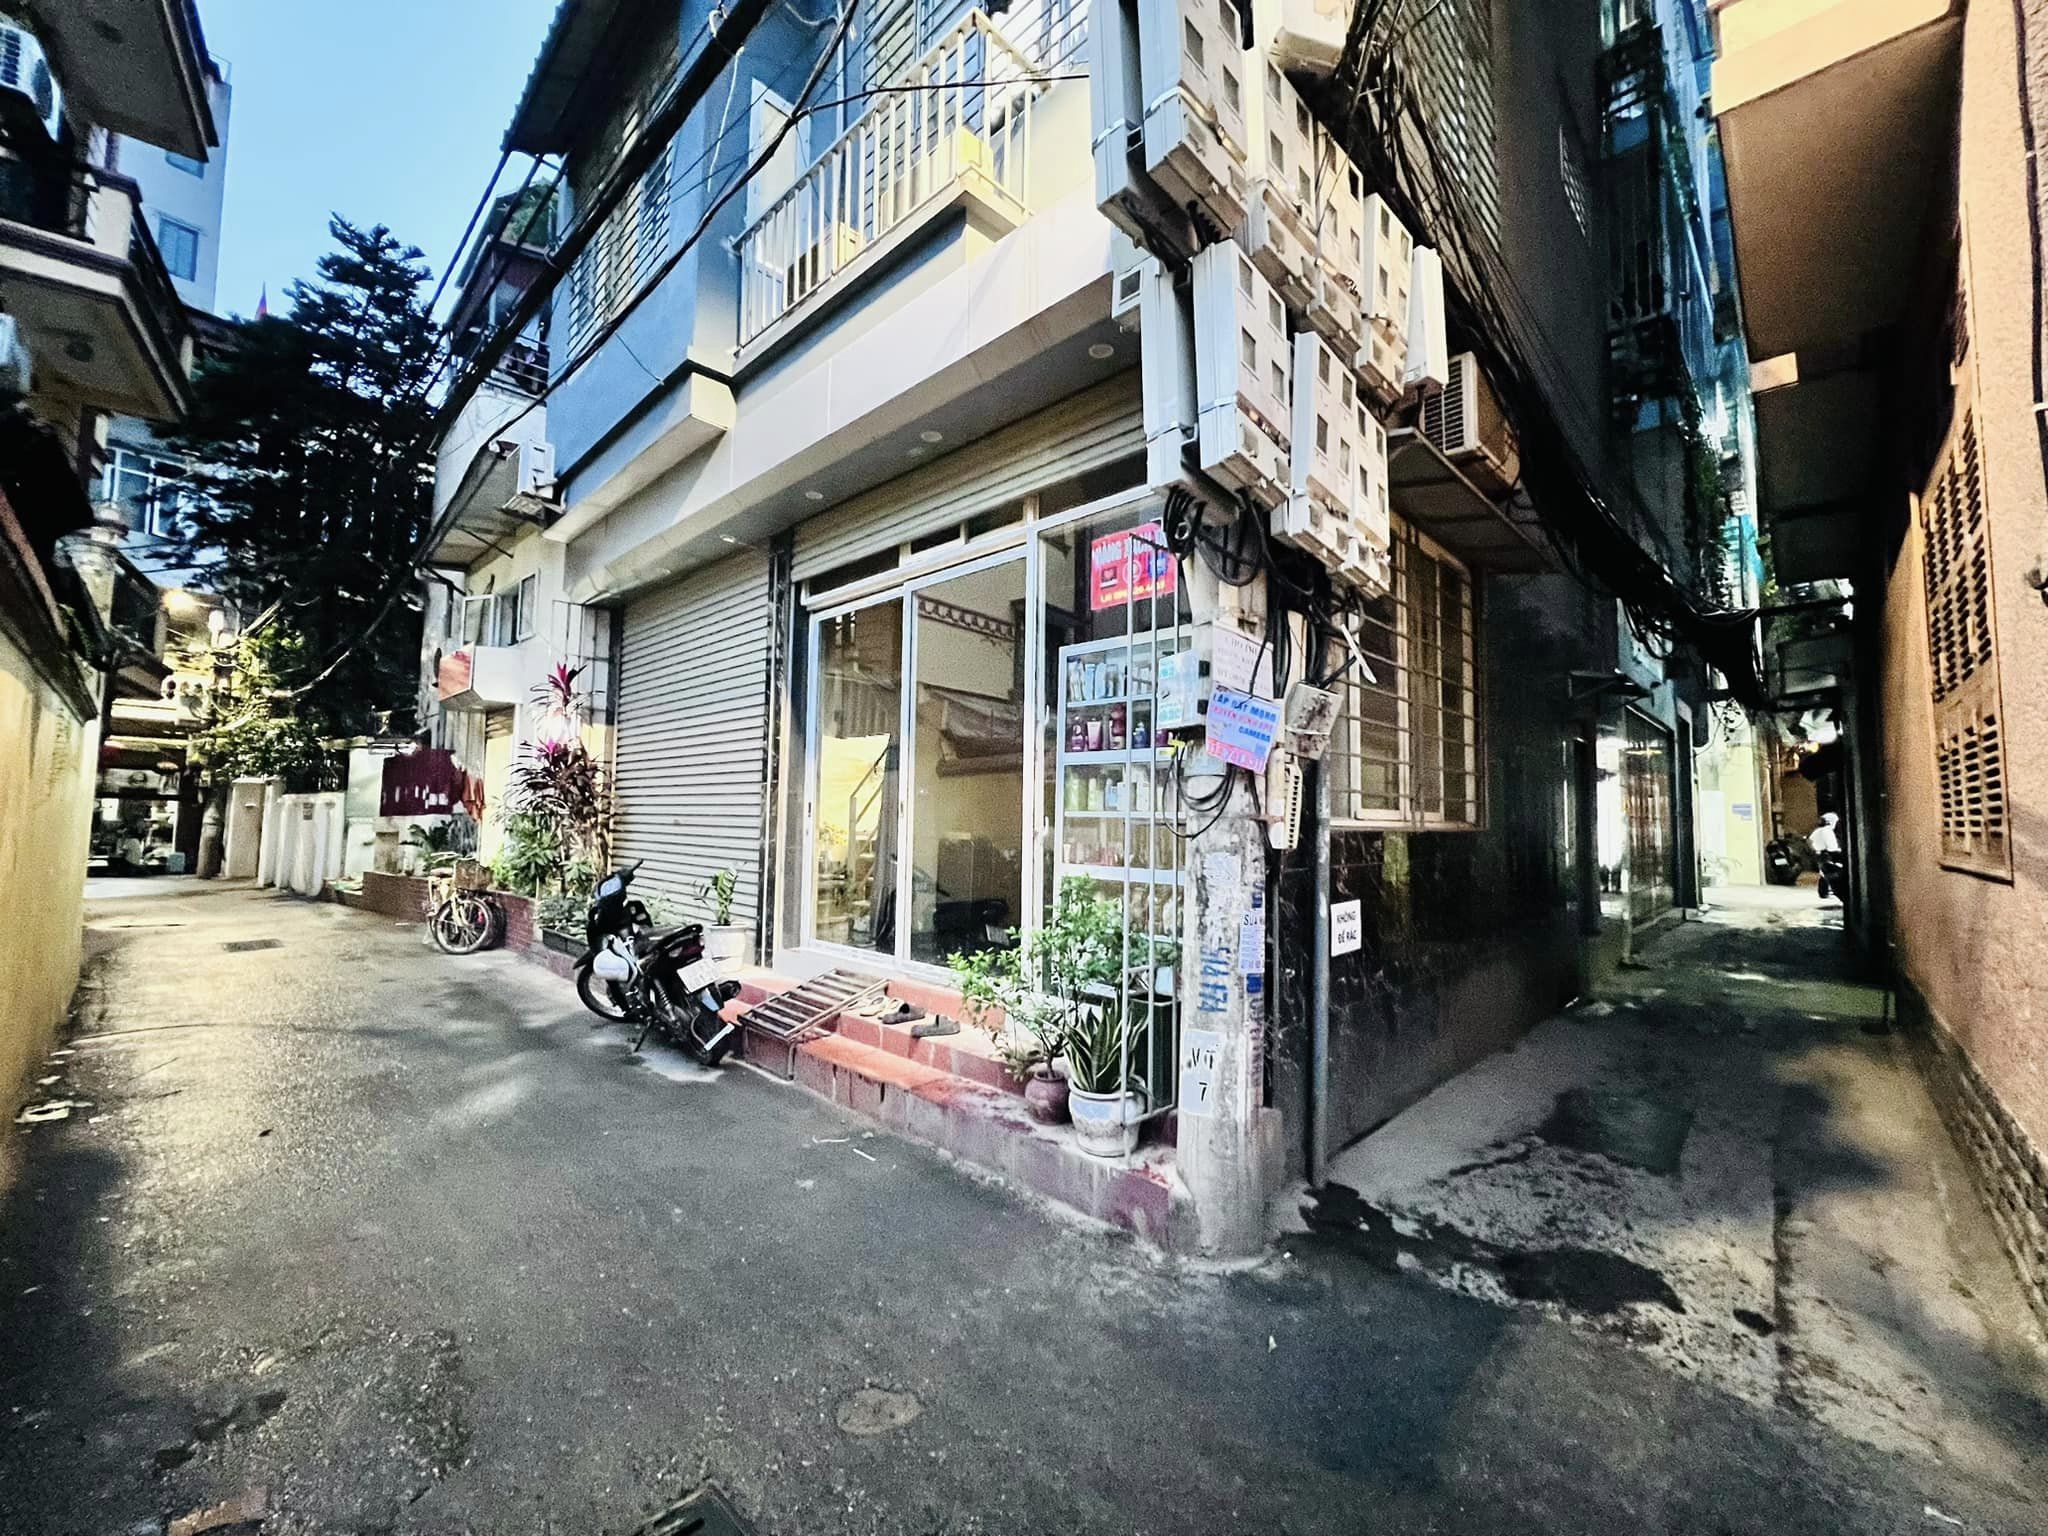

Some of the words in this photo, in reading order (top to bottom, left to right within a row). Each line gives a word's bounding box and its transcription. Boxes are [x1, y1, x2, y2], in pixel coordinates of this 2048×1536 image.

[1238, 725, 1271, 742] CAMERA
[1336, 911, 1357, 924] KHÔNG
[1198, 1081, 1208, 1102] 7
